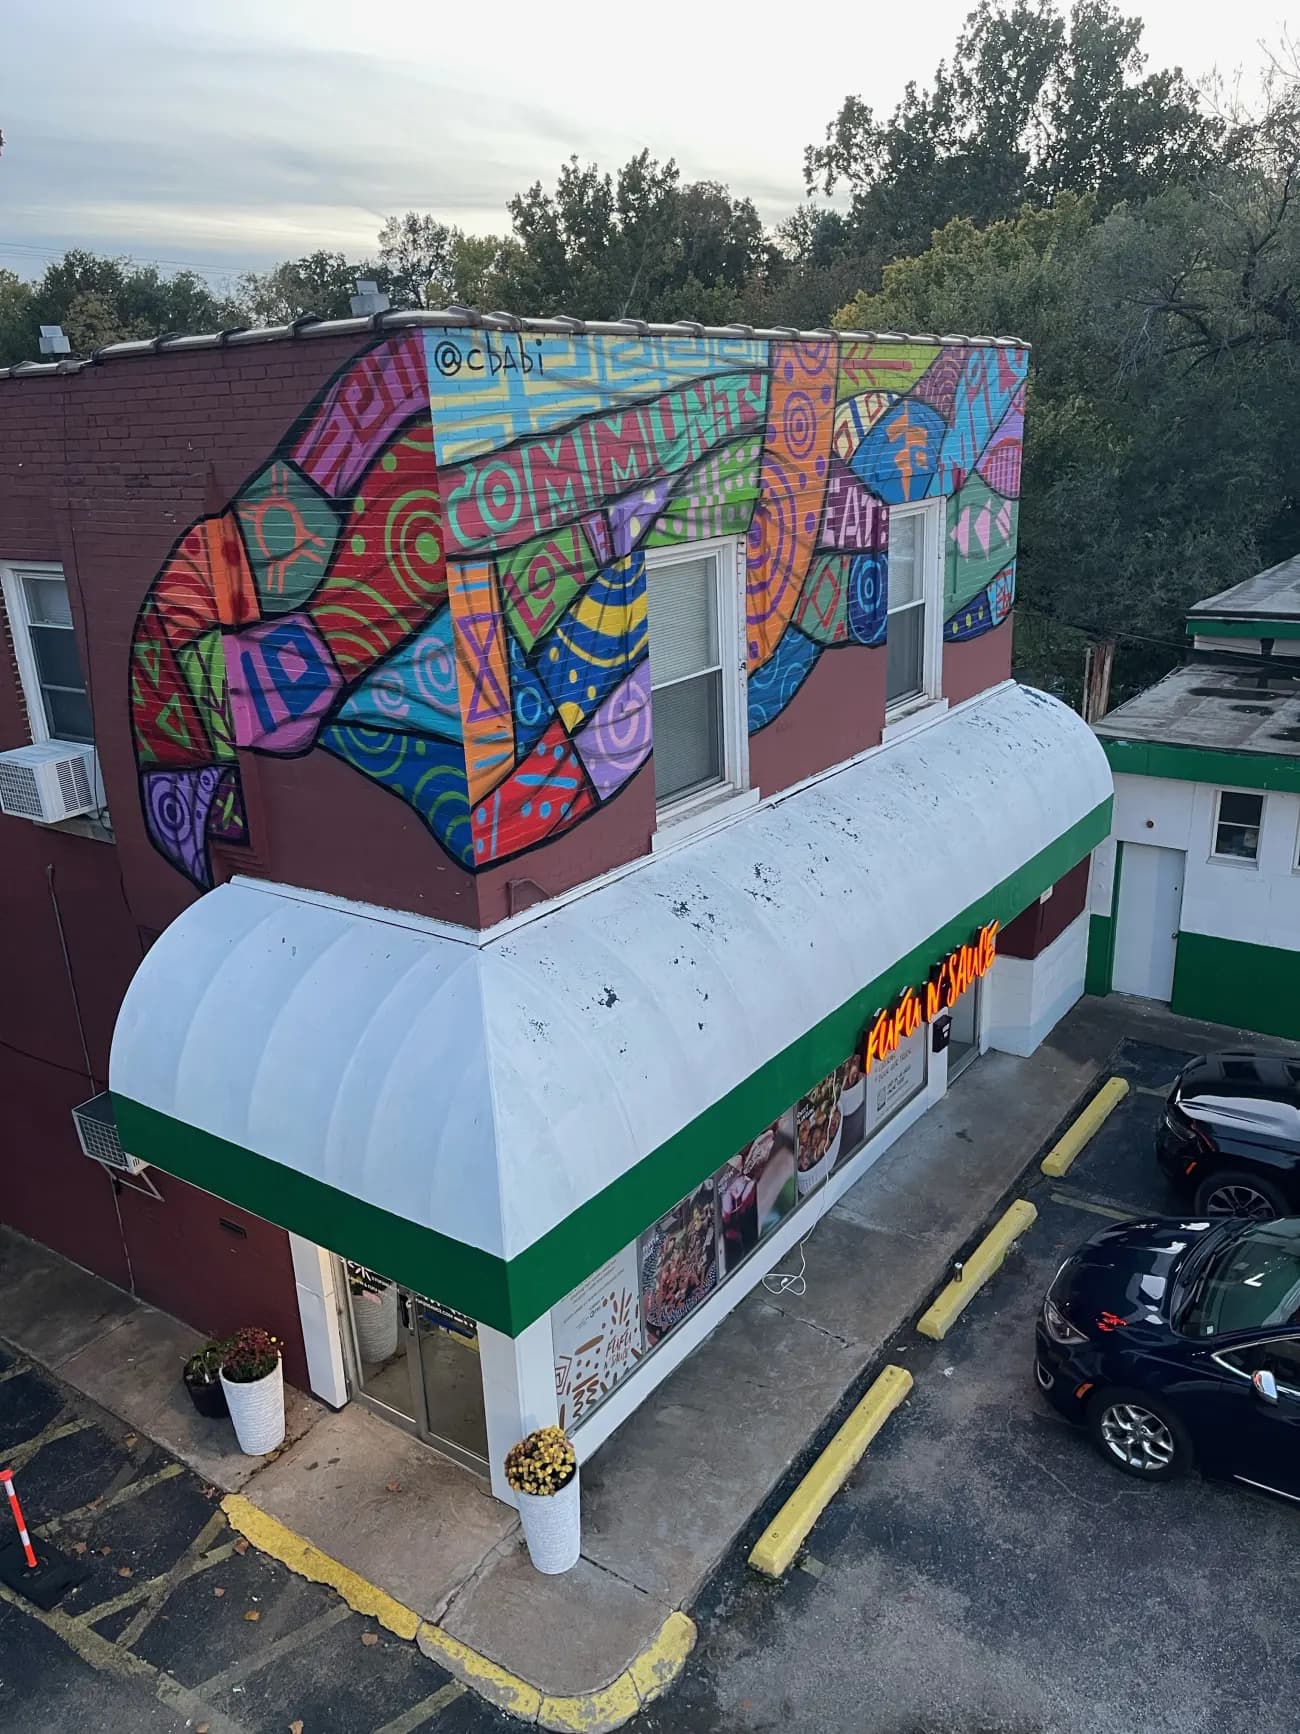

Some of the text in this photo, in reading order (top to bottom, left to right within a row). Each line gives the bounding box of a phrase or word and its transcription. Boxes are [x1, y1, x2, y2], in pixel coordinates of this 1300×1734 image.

[448, 374, 768, 551] COMMUNITY
[865, 986, 921, 1075] FUFU
[947, 919, 1000, 1008] SAUCE
